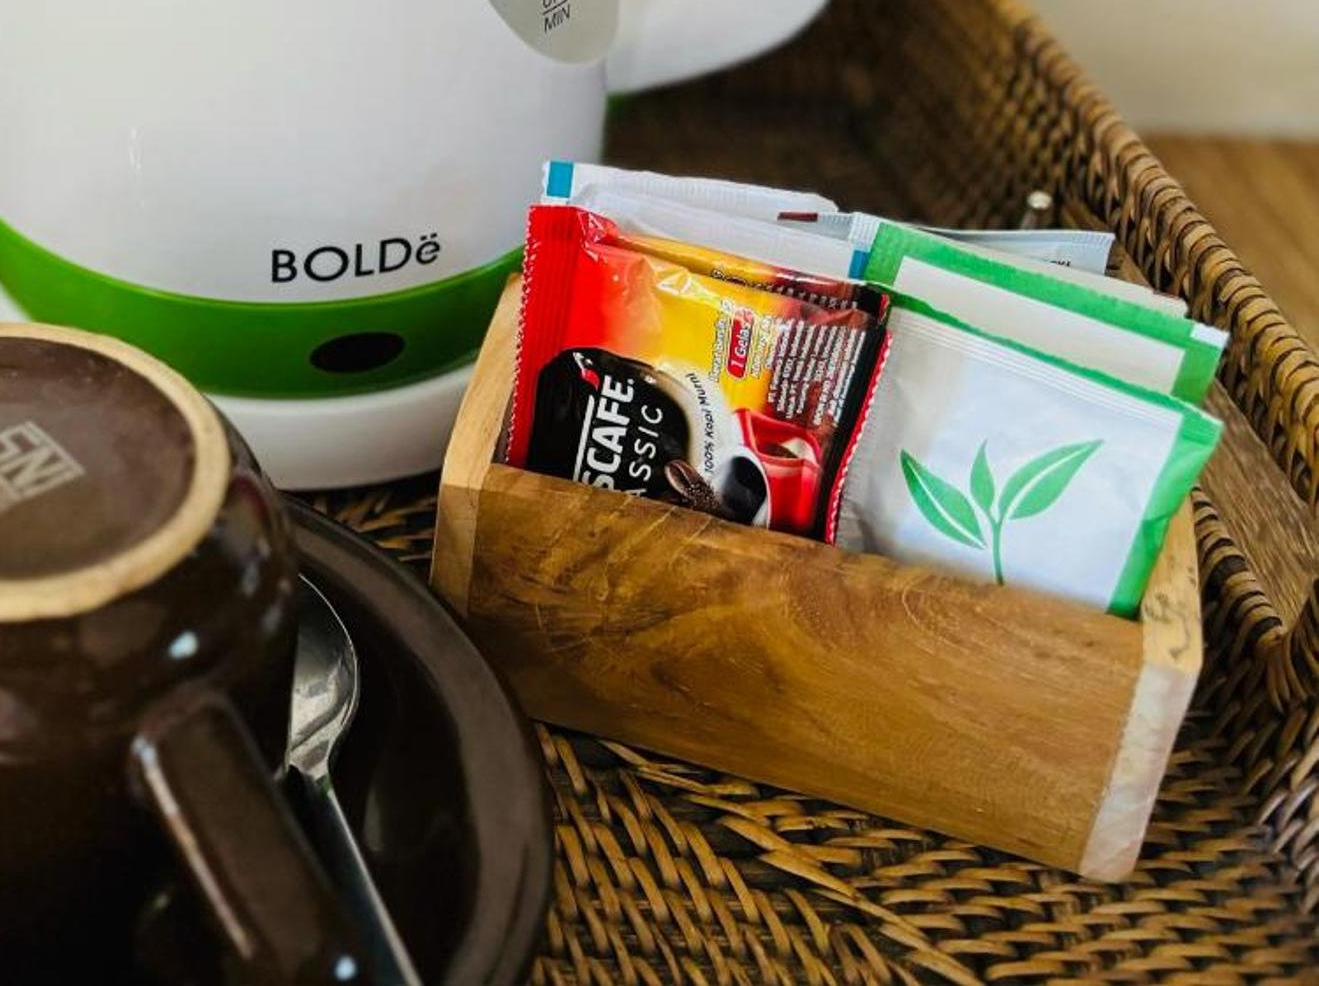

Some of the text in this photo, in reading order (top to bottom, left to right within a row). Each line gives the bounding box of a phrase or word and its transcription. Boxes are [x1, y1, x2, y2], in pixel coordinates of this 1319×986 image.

[544, 4, 572, 33] MIN
[272, 233, 440, 283] BOLDë
[734, 321, 751, 358] Gelas
[686, 372, 715, 475] 100% Kopi Murni
[624, 404, 664, 498] ASSIC
